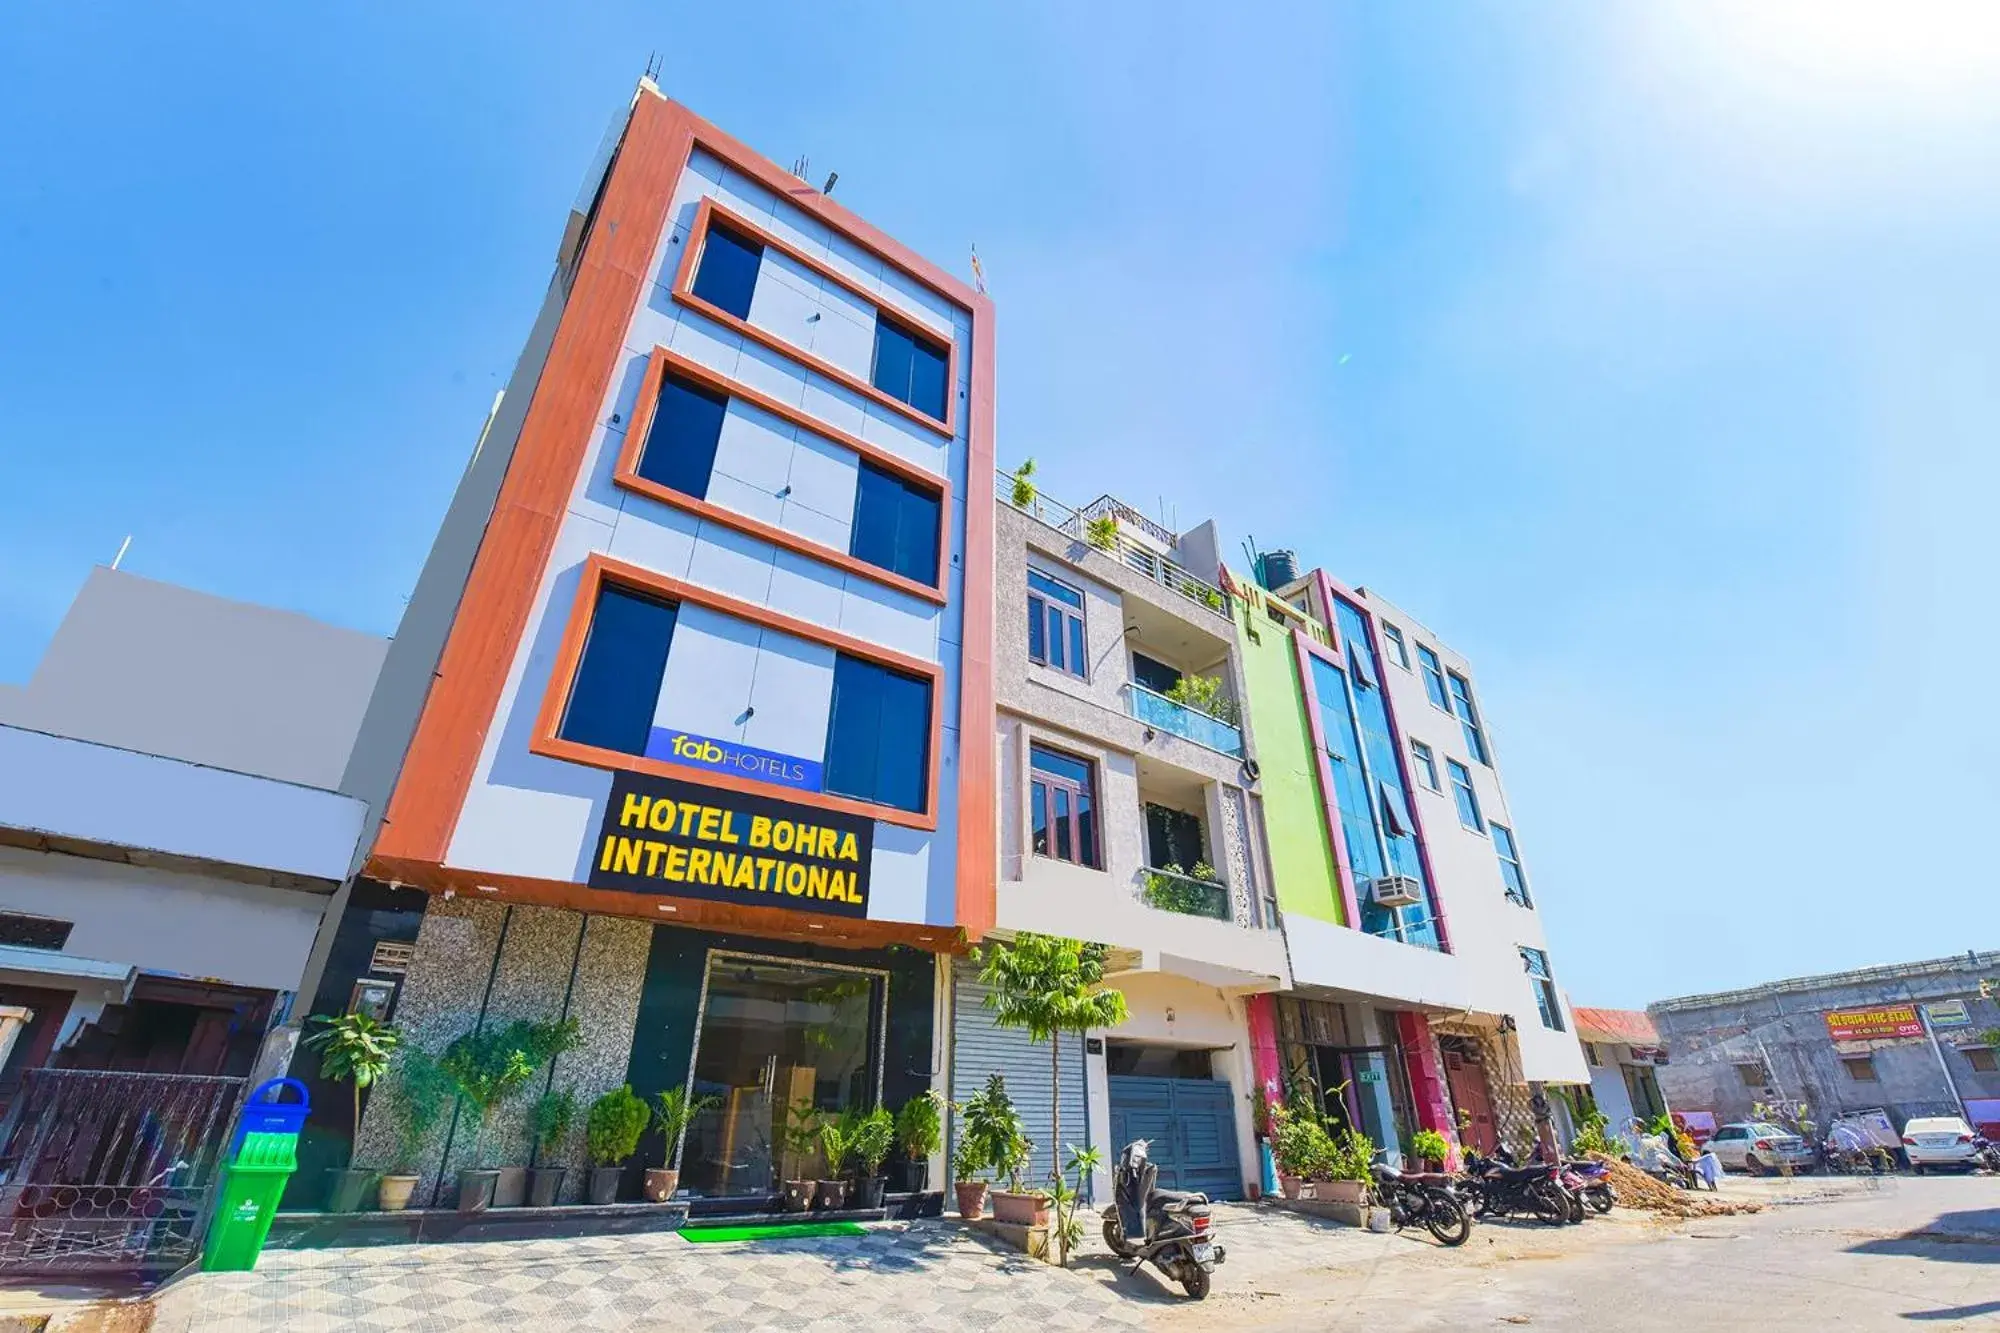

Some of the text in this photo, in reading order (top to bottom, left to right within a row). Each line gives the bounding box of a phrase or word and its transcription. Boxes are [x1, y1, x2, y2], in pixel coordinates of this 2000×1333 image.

[671, 735, 804, 781] fabHOTELS
[619, 793, 859, 862] HOTEL BOHRA
[600, 835, 863, 904] INTERNATIONAL
